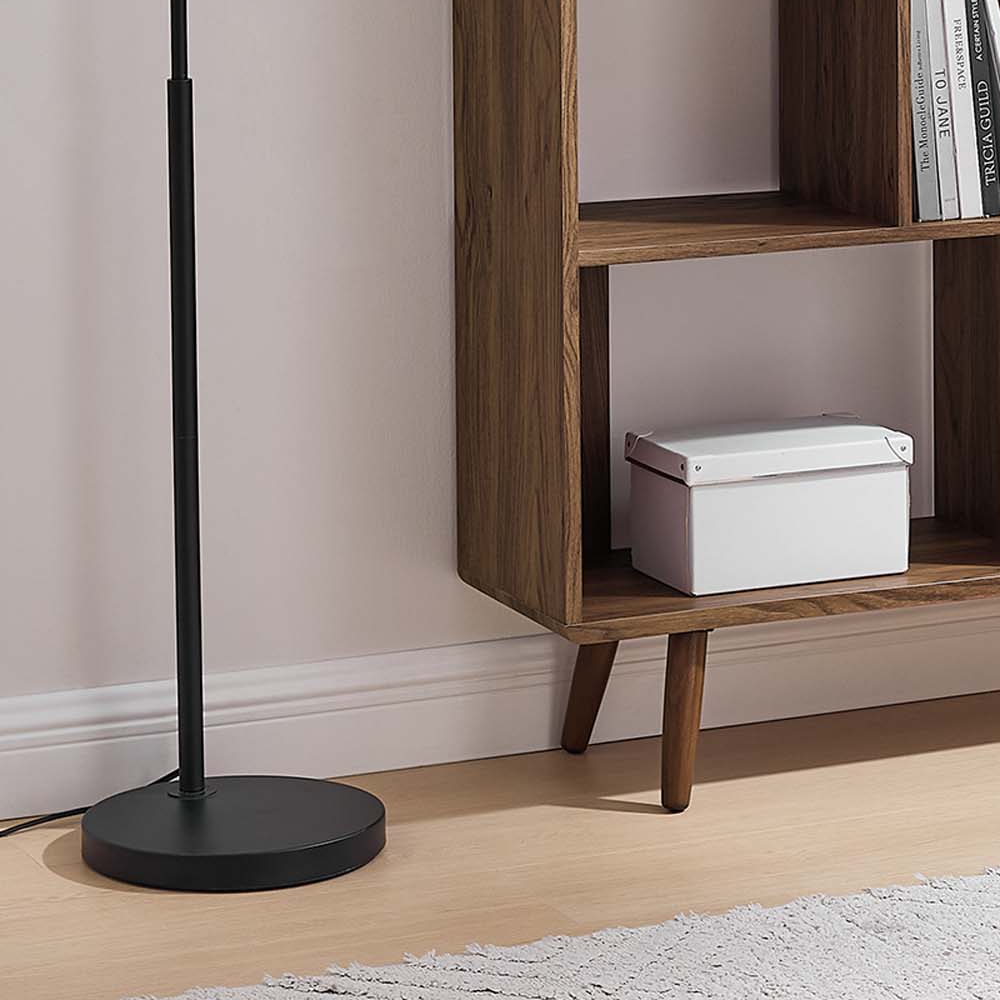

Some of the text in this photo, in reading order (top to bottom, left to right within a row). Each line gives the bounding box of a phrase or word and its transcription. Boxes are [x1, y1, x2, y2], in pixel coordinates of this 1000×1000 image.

[952, 18, 967, 90] FREE&SPACE
[972, 20, 984, 53] CERTAIN
[975, 53, 984, 61] A
[934, 68, 951, 139] TO JANE
[976, 80, 993, 131] GUILD
[920, 151, 930, 172] The
[981, 131, 997, 188] TRICIA
